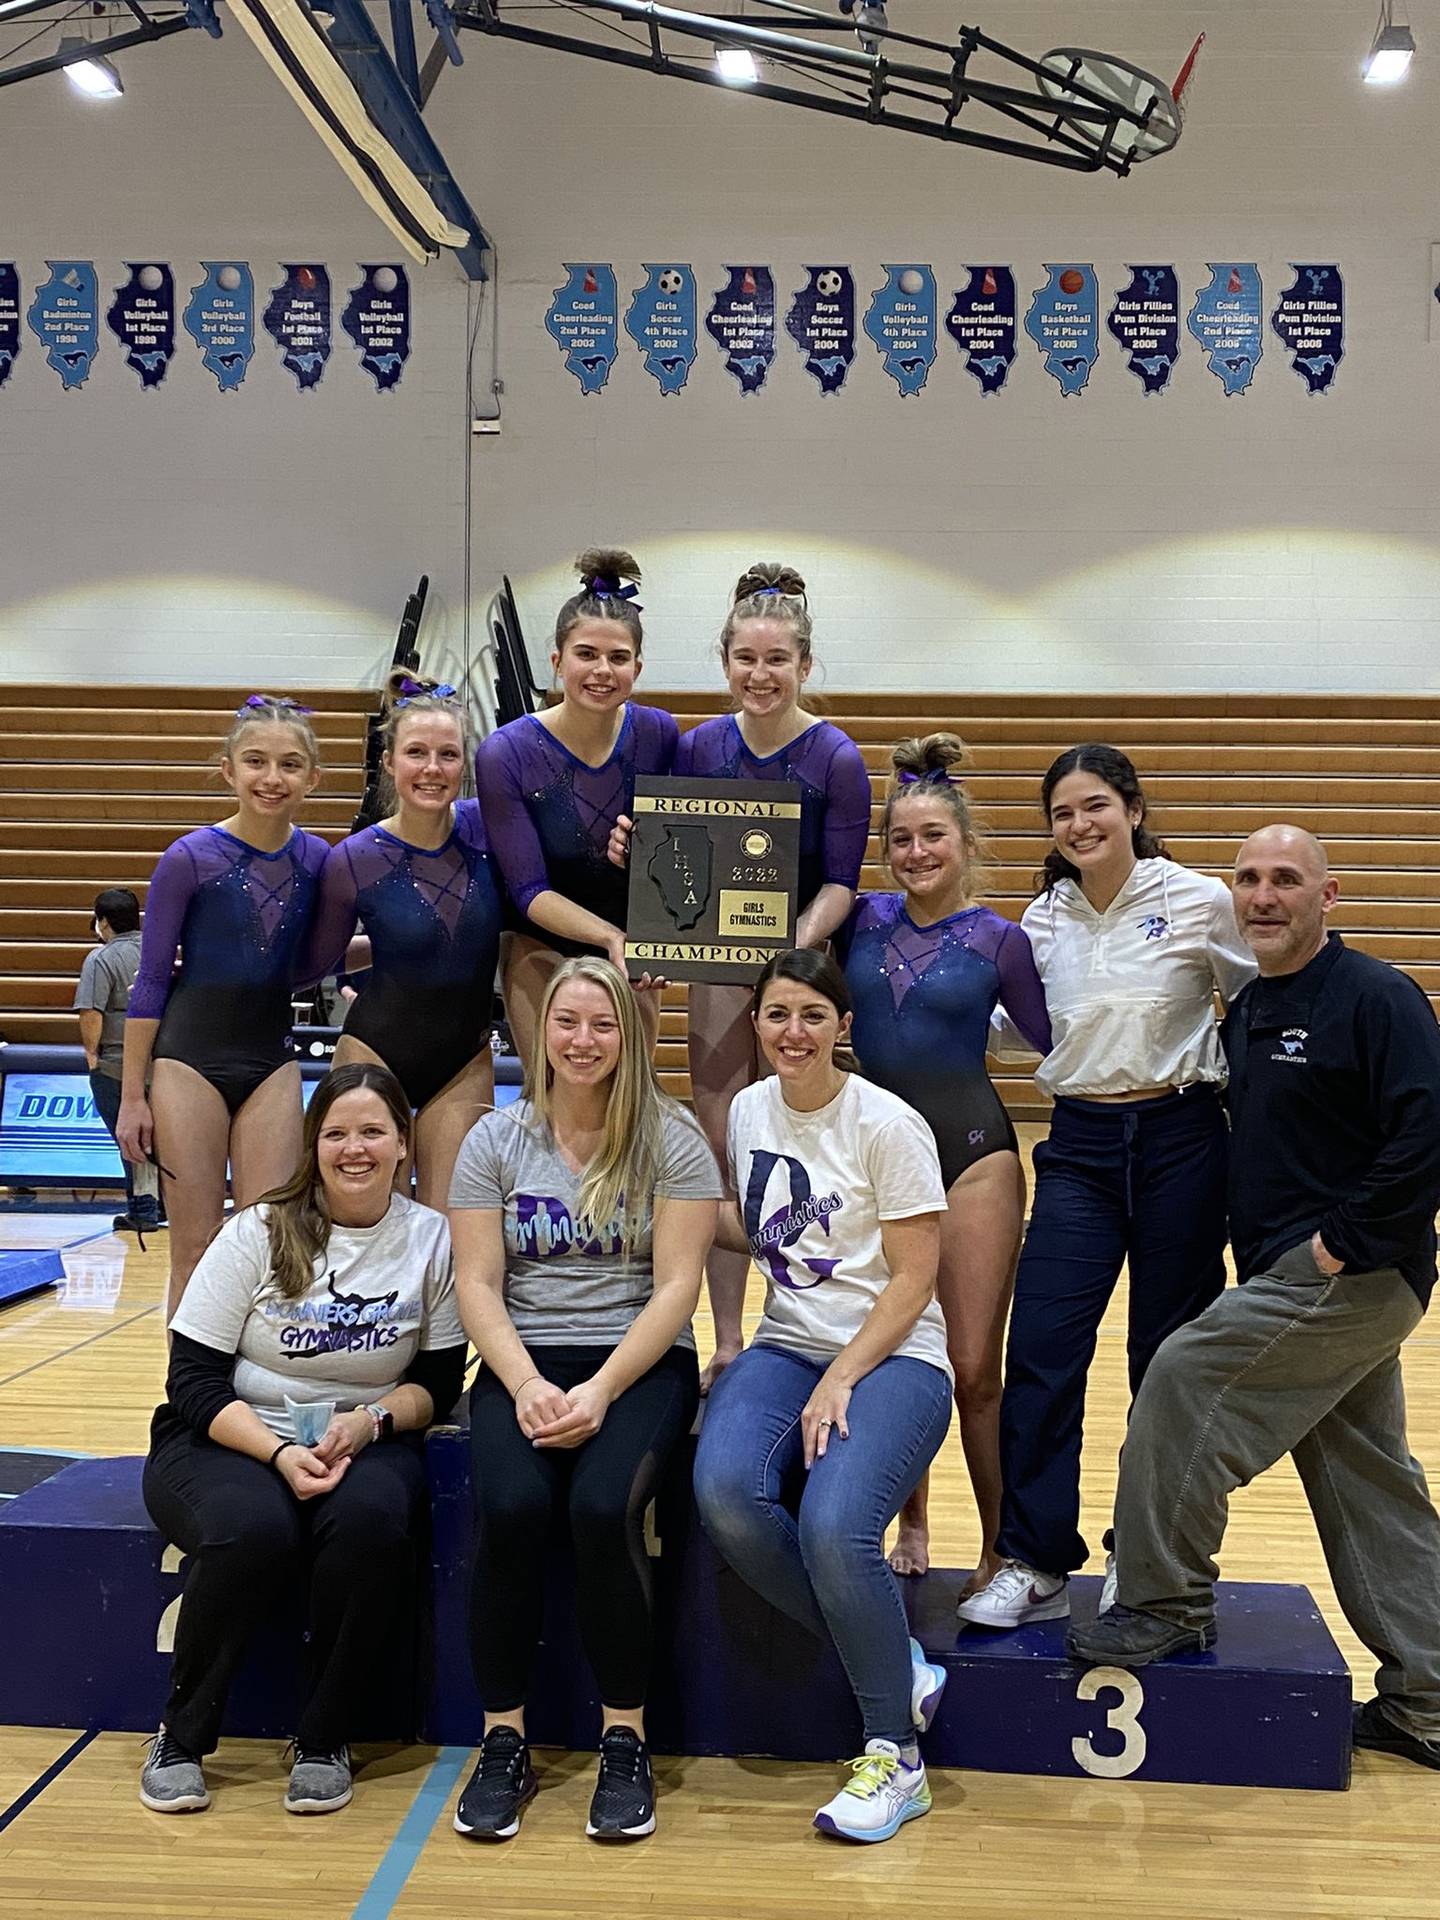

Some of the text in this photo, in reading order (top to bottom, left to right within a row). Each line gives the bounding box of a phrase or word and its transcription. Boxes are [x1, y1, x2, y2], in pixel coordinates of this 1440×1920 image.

[57, 298, 78, 307] Girls
[136, 299, 157, 307] Girls
[213, 299, 233, 308] Girls
[291, 300, 314, 309] Boys
[371, 300, 392, 309] Girls
[572, 301, 594, 310] Coed
[656, 301, 676, 310] Girls
[731, 302, 753, 311] Coed
[895, 303, 916, 311] Girls
[971, 302, 994, 311] Coed
[1055, 302, 1078, 312] Boys
[1119, 301, 1172, 310] Girls Fillies
[1217, 301, 1240, 310] Coed
[1283, 301, 1337, 310] Girls Fillies
[816, 303, 839, 313] Boys
[43, 310, 91, 319] Badminton
[124, 311, 169, 321] Volleyball
[202, 311, 245, 322] Volleyball
[284, 312, 320, 320] Football
[359, 312, 404, 322] Volleyball
[553, 314, 613, 324] Cheerleading
[650, 315, 682, 323] Soccer
[1041, 315, 1090, 323] Basketball
[1138, 314, 1176, 323] Division
[1196, 314, 1259, 324] Cheerleading
[1302, 314, 1341, 323] Division
[711, 315, 772, 326] Cheerleading
[811, 316, 844, 324] Soccer
[883, 315, 928, 326] Volleyball
[952, 315, 1013, 326] Cheerleading
[44, 323, 89, 331] 2nd Place
[126, 323, 166, 332] 1st Place
[202, 324, 244, 332] 3rd Place
[282, 324, 322, 334] 1st Place
[361, 325, 401, 334] 1st Place
[560, 326, 606, 335] 2nd Place
[644, 327, 688, 336] 4th Place
[723, 327, 764, 336] 1st Place
[1043, 327, 1087, 336] 3rd Place
[1124, 327, 1166, 336] 1st Place
[1204, 327, 1252, 335] 2nd Place
[1288, 327, 1331, 336] 1st Place
[806, 328, 847, 336] 1st Place
[883, 328, 927, 336] 4th Place
[962, 328, 1003, 336] 1st Place
[135, 336, 157, 344] 1999
[211, 336, 235, 344] 2000
[291, 337, 313, 345] 2001
[369, 338, 393, 346] 2002
[571, 339, 595, 347] 2002
[654, 339, 678, 348] 2002
[814, 340, 839, 349] 2004
[893, 340, 917, 349] 2004
[969, 340, 994, 349] 2004
[1053, 340, 1078, 348] 2005
[1132, 340, 1157, 348] 2005
[654, 799, 780, 816] REGIONAL
[732, 866, 778, 883] 2022
[743, 902, 764, 913] GIRLS
[730, 914, 777, 927] GYMNASTICS
[749, 1191, 843, 1260] ymnastics
[265, 1301, 420, 1325] DOWNERS GROVE
[280, 1325, 399, 1352] GYMNASTICS
[1071, 1666, 1146, 1778] 3
